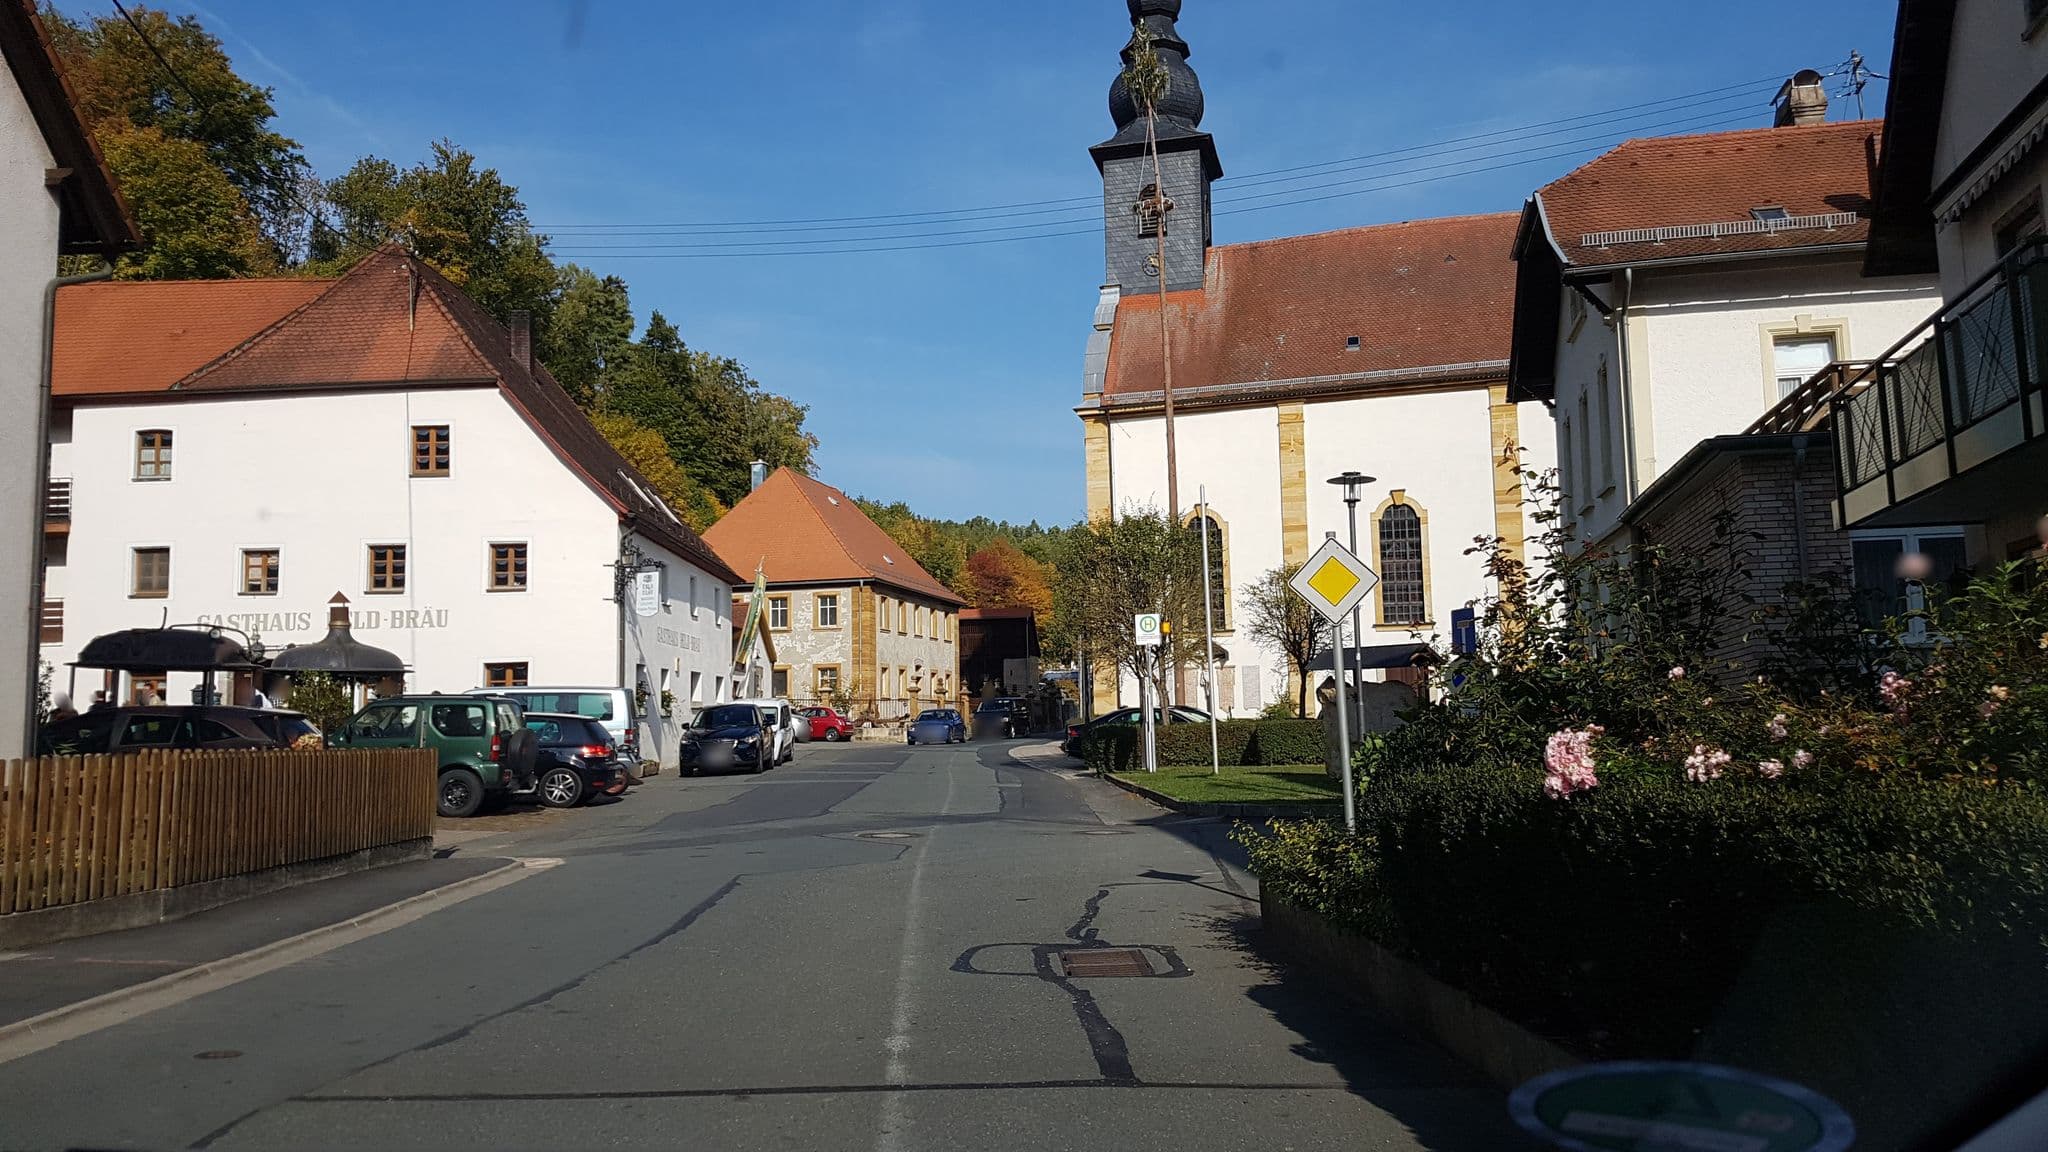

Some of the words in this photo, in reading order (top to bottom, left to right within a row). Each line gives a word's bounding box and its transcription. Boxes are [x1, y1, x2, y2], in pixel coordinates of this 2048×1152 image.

[197, 612, 311, 632] GASTHAUS
[327, 606, 449, 630] LD-BRÄU
[1144, 619, 1152, 629] H
